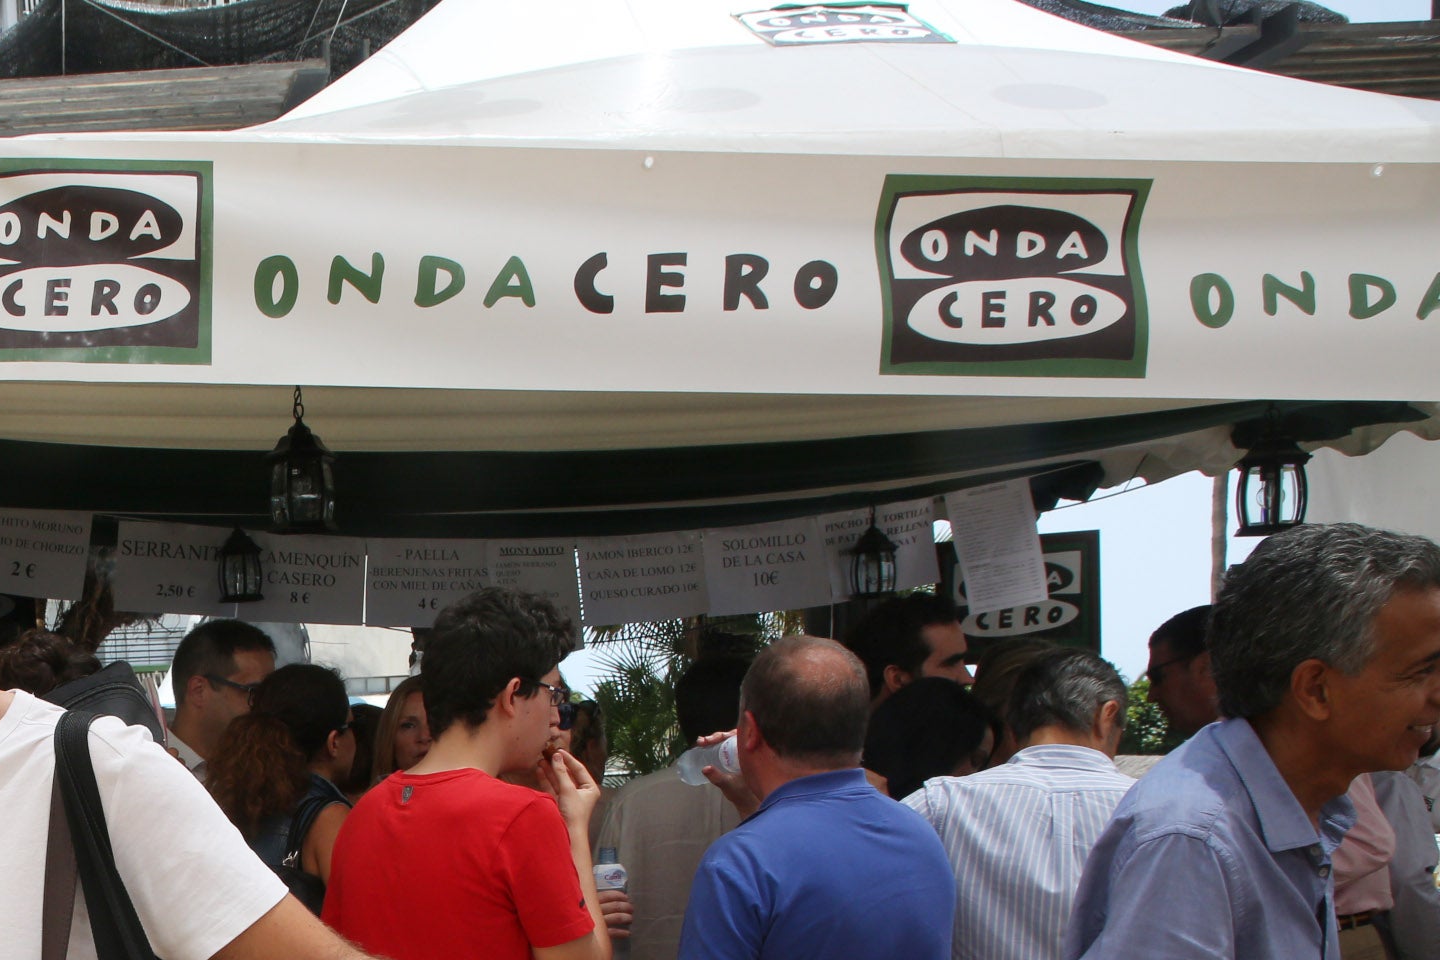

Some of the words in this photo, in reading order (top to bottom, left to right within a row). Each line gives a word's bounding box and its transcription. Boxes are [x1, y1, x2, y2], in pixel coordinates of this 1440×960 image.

[767, 14, 897, 27] ONDA
[920, 229, 1089, 262] ONDA
[254, 252, 536, 319] ONDA
[574, 252, 838, 314] CERO
[1, 278, 162, 318] CERO
[938, 291, 1098, 329] CERO
[32, 519, 83, 536] MORUNO
[824, 518, 864, 533] PINCHO
[886, 519, 930, 536] RELLENA
[15, 538, 31, 549] DE
[32, 540, 85, 555] CHORIZO
[121, 539, 220, 561] SERRANIT
[722, 533, 807, 552] SOLOMILLO
[405, 548, 460, 561] PAELLA
[499, 546, 565, 557] MONTADITO
[585, 550, 624, 561] JAMON
[627, 545, 674, 559] IBERICO
[677, 543, 695, 554] 12€
[722, 556, 742, 568] DE
[744, 555, 763, 567] LA
[765, 551, 806, 565] CASA
[9, 560, 20, 577] 2
[25, 562, 37, 578] €
[266, 551, 360, 570] AMENQUÍN
[266, 570, 336, 587] CASERO
[448, 567, 489, 577] FRITAS
[587, 568, 620, 580] CAÑA
[622, 568, 639, 578] DE
[640, 565, 676, 577] LOMO
[679, 562, 697, 573] 12€
[753, 570, 780, 587] 10€
[155, 584, 184, 598] 2,50
[187, 585, 197, 598] €
[372, 581, 397, 590] CON
[400, 580, 429, 590] MIEL
[432, 580, 448, 590] DE
[449, 579, 484, 591] CAÑA
[590, 587, 628, 601] QUESO
[630, 583, 680, 597] CURADO
[681, 582, 700, 593] 10€
[289, 591, 299, 603] 8
[301, 591, 312, 604] €
[418, 597, 426, 609] 4
[430, 597, 439, 609] €
[976, 606, 1064, 630] CERO
